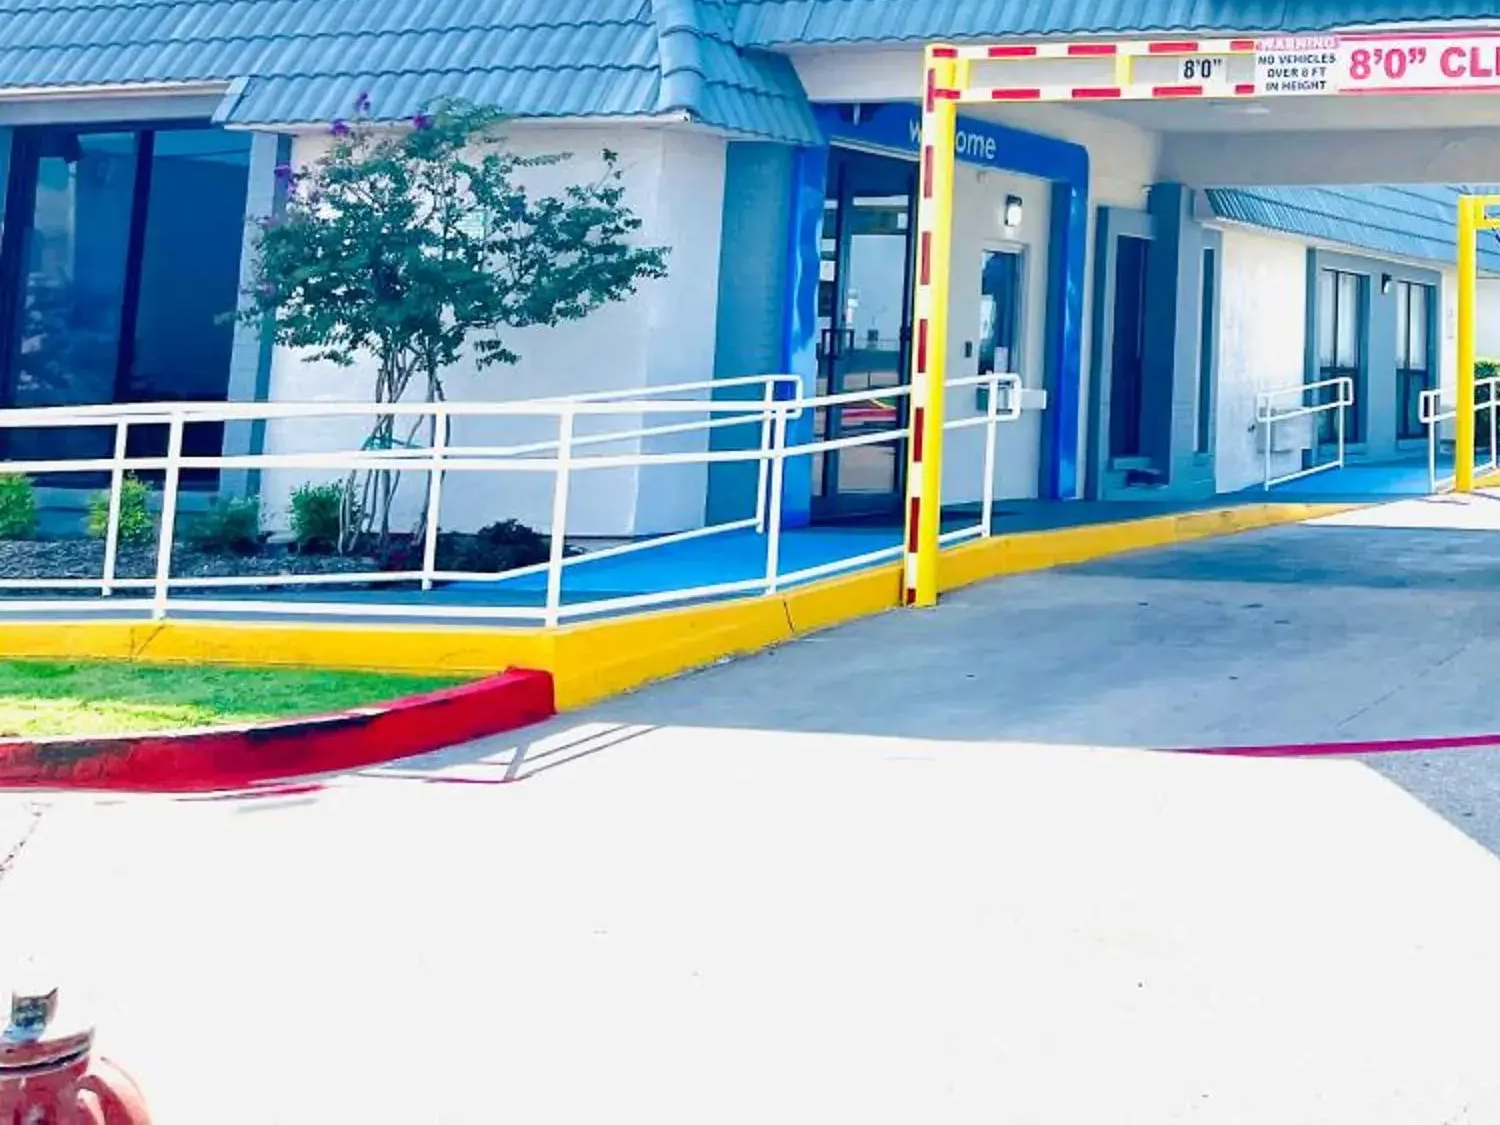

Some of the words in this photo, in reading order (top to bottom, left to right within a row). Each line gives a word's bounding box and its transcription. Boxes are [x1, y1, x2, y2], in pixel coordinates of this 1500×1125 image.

[1258, 55, 1275, 64] NO
[1279, 53, 1336, 63] VEHICLES
[1350, 47, 1427, 79] 8'0"
[1184, 59, 1222, 79] 8'0"
[1267, 68, 1298, 77] OVER
[1301, 69, 1308, 77] 8
[1311, 67, 1326, 77] FT
[1266, 82, 1278, 91] IN
[1282, 81, 1326, 91] HEIGHT
[909, 117, 997, 160] wome
